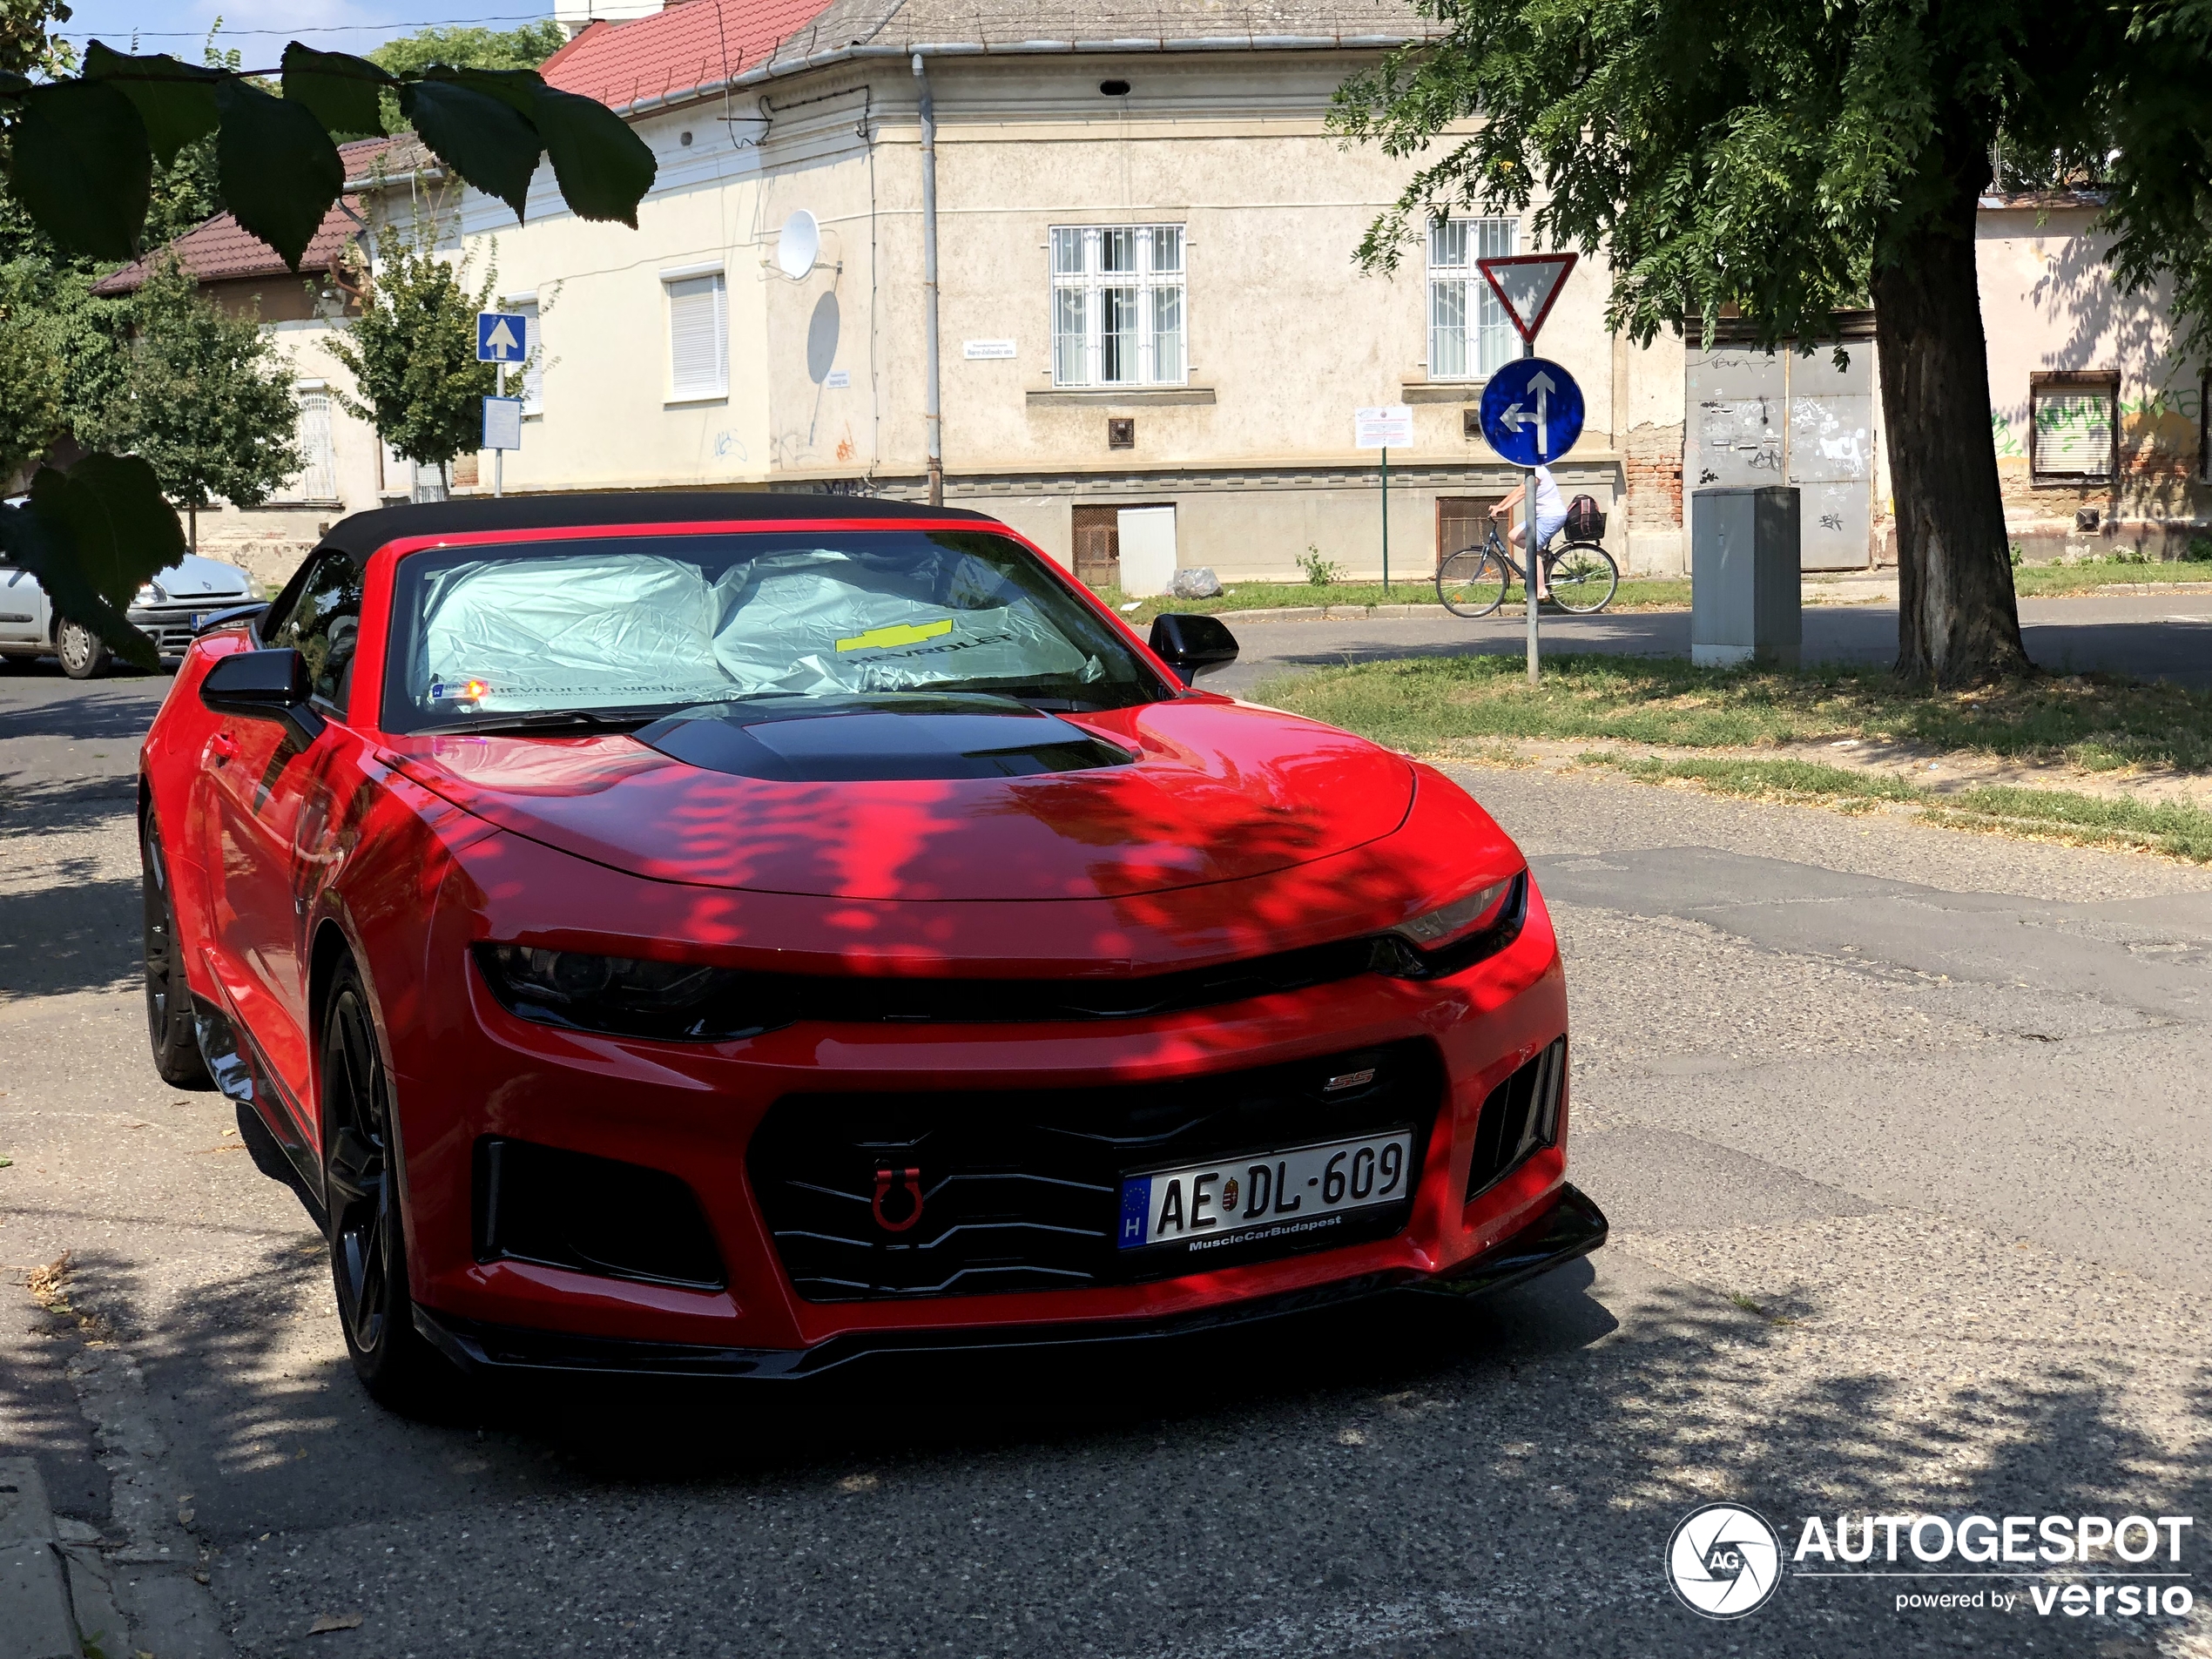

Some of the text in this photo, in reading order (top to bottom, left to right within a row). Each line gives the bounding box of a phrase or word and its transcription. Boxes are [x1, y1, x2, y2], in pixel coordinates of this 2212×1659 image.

[1323, 1068, 1376, 1092] SS
[1156, 1172, 1219, 1235] AE
[1125, 1216, 1140, 1238] H
[1188, 1215, 1342, 1252] MuscleCarBudapest
